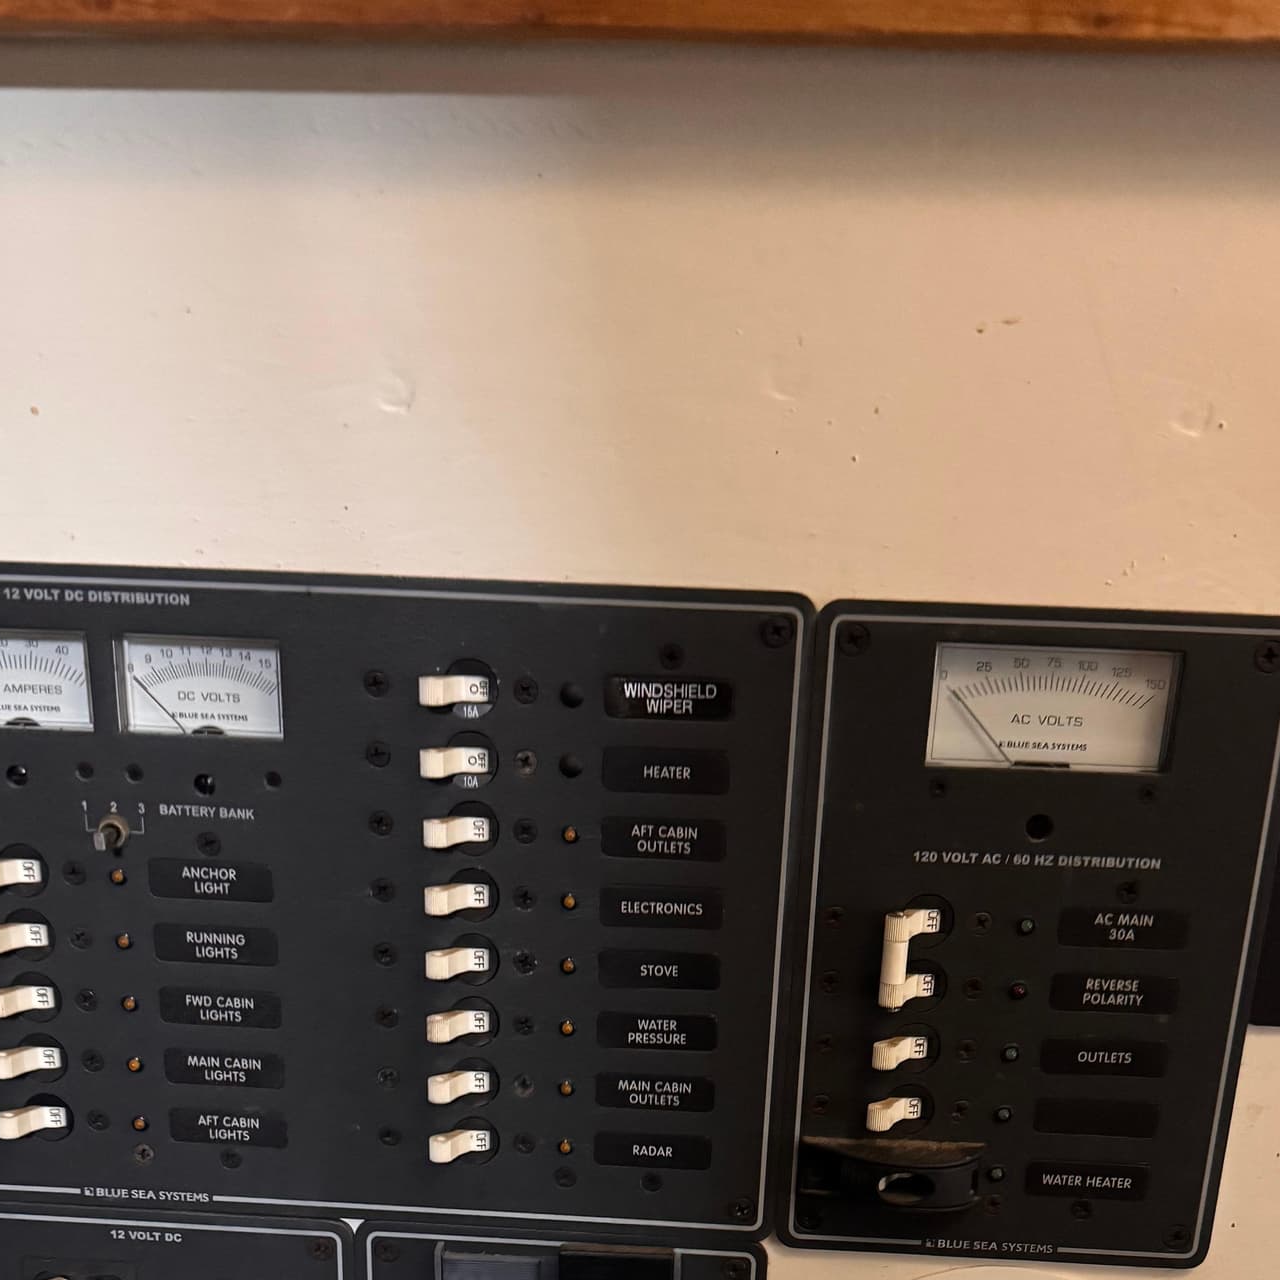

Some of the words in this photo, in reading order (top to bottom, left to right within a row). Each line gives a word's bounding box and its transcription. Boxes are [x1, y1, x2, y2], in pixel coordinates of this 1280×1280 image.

[3, 588, 20, 600] 12
[23, 588, 60, 601] VOLT
[64, 589, 85, 602] DC
[88, 590, 191, 606] DISTRIBUTION
[25, 639, 39, 649] 30
[55, 644, 69, 656] 40
[180, 645, 192, 656] 11
[201, 644, 214, 655] 12
[160, 648, 174, 659] 10
[220, 647, 233, 658] 13
[239, 650, 252, 661] 14
[259, 658, 272, 670] 15
[976, 661, 993, 673] 25
[1014, 657, 1031, 670] 50
[1047, 657, 1064, 669] 75
[1078, 660, 1099, 673] 100
[1111, 667, 1132, 679] 125
[3, 683, 63, 696] AMPERES
[623, 682, 718, 700] WINDSHIELD
[1145, 678, 1166, 690] 150
[177, 690, 197, 702] DC
[201, 691, 241, 704] VOLTS
[13, 704, 30, 713] SEA
[30, 704, 61, 714] SYSTEMS
[646, 698, 693, 715] WIPER
[178, 710, 199, 720] BLUE
[200, 711, 217, 721] SEA
[218, 712, 249, 722] SYSTEMS
[1010, 713, 1031, 726] AC
[1038, 714, 1084, 728] VOLTS
[1031, 741, 1050, 751] SEA
[1051, 742, 1088, 752] SYSTEMS
[643, 765, 691, 780] HEATER
[81, 800, 87, 811] 1
[110, 802, 118, 813] 2
[138, 803, 145, 814] 3
[159, 804, 216, 818] BATTERY
[219, 807, 255, 820] BANK
[631, 824, 654, 838] AFT
[658, 825, 698, 840] CABIN
[637, 840, 691, 855] OUTLETS
[912, 850, 938, 863] 120
[941, 851, 979, 865] VOLT
[981, 852, 1002, 865] AC
[1034, 854, 1055, 867] HZ
[1058, 855, 1162, 870] DISTRIBUTION
[22, 861, 36, 881] OFF
[181, 866, 237, 881] ANCHOR
[194, 881, 231, 895] LIGHT
[620, 900, 704, 916] ELECTRONICS
[927, 911, 939, 930] OFF
[1094, 912, 1114, 926] AC
[1117, 913, 1154, 927] MAIN
[29, 925, 43, 945] OFF
[186, 930, 246, 946] RUNNING
[1108, 928, 1136, 941] 30A
[195, 945, 239, 960] LIGHTS
[640, 964, 679, 978] STOVE
[1086, 978, 1140, 992] REVERSE
[36, 987, 50, 1008] OFF
[185, 994, 213, 1008] FWD
[216, 996, 255, 1010] CABIN
[1082, 992, 1144, 1007] POLARITY
[199, 1009, 243, 1023] LIGHTS
[637, 1019, 678, 1032] WATER
[627, 1031, 687, 1046] PRESSURE
[914, 1037, 925, 1057] OFF
[42, 1048, 57, 1069] OFF
[187, 1055, 221, 1068] MAIN
[224, 1057, 262, 1070] CABIN
[1077, 1051, 1133, 1065] OUTLETS
[204, 1070, 247, 1083] LIGHTS
[618, 1079, 651, 1092] MAIN
[654, 1081, 692, 1094] CABIN
[629, 1093, 680, 1107] OUTLETS
[909, 1098, 919, 1117] OFF
[198, 1114, 220, 1127] AFT
[223, 1115, 260, 1129] CABIN
[209, 1128, 251, 1141] LIGHTS
[632, 1144, 673, 1158] RADAR
[1042, 1173, 1082, 1187] WATER
[1086, 1175, 1132, 1189] HEATER
[96, 1187, 129, 1199] BLUE
[131, 1188, 157, 1200] SEA
[158, 1190, 210, 1203] SYSTEMS
[110, 1229, 125, 1240] 12
[128, 1230, 162, 1242] VOLT
[164, 1232, 183, 1243] DC
[937, 1239, 971, 1251] BLUE
[973, 1240, 998, 1252] SEA
[1001, 1242, 1054, 1255] SYSTEMS
